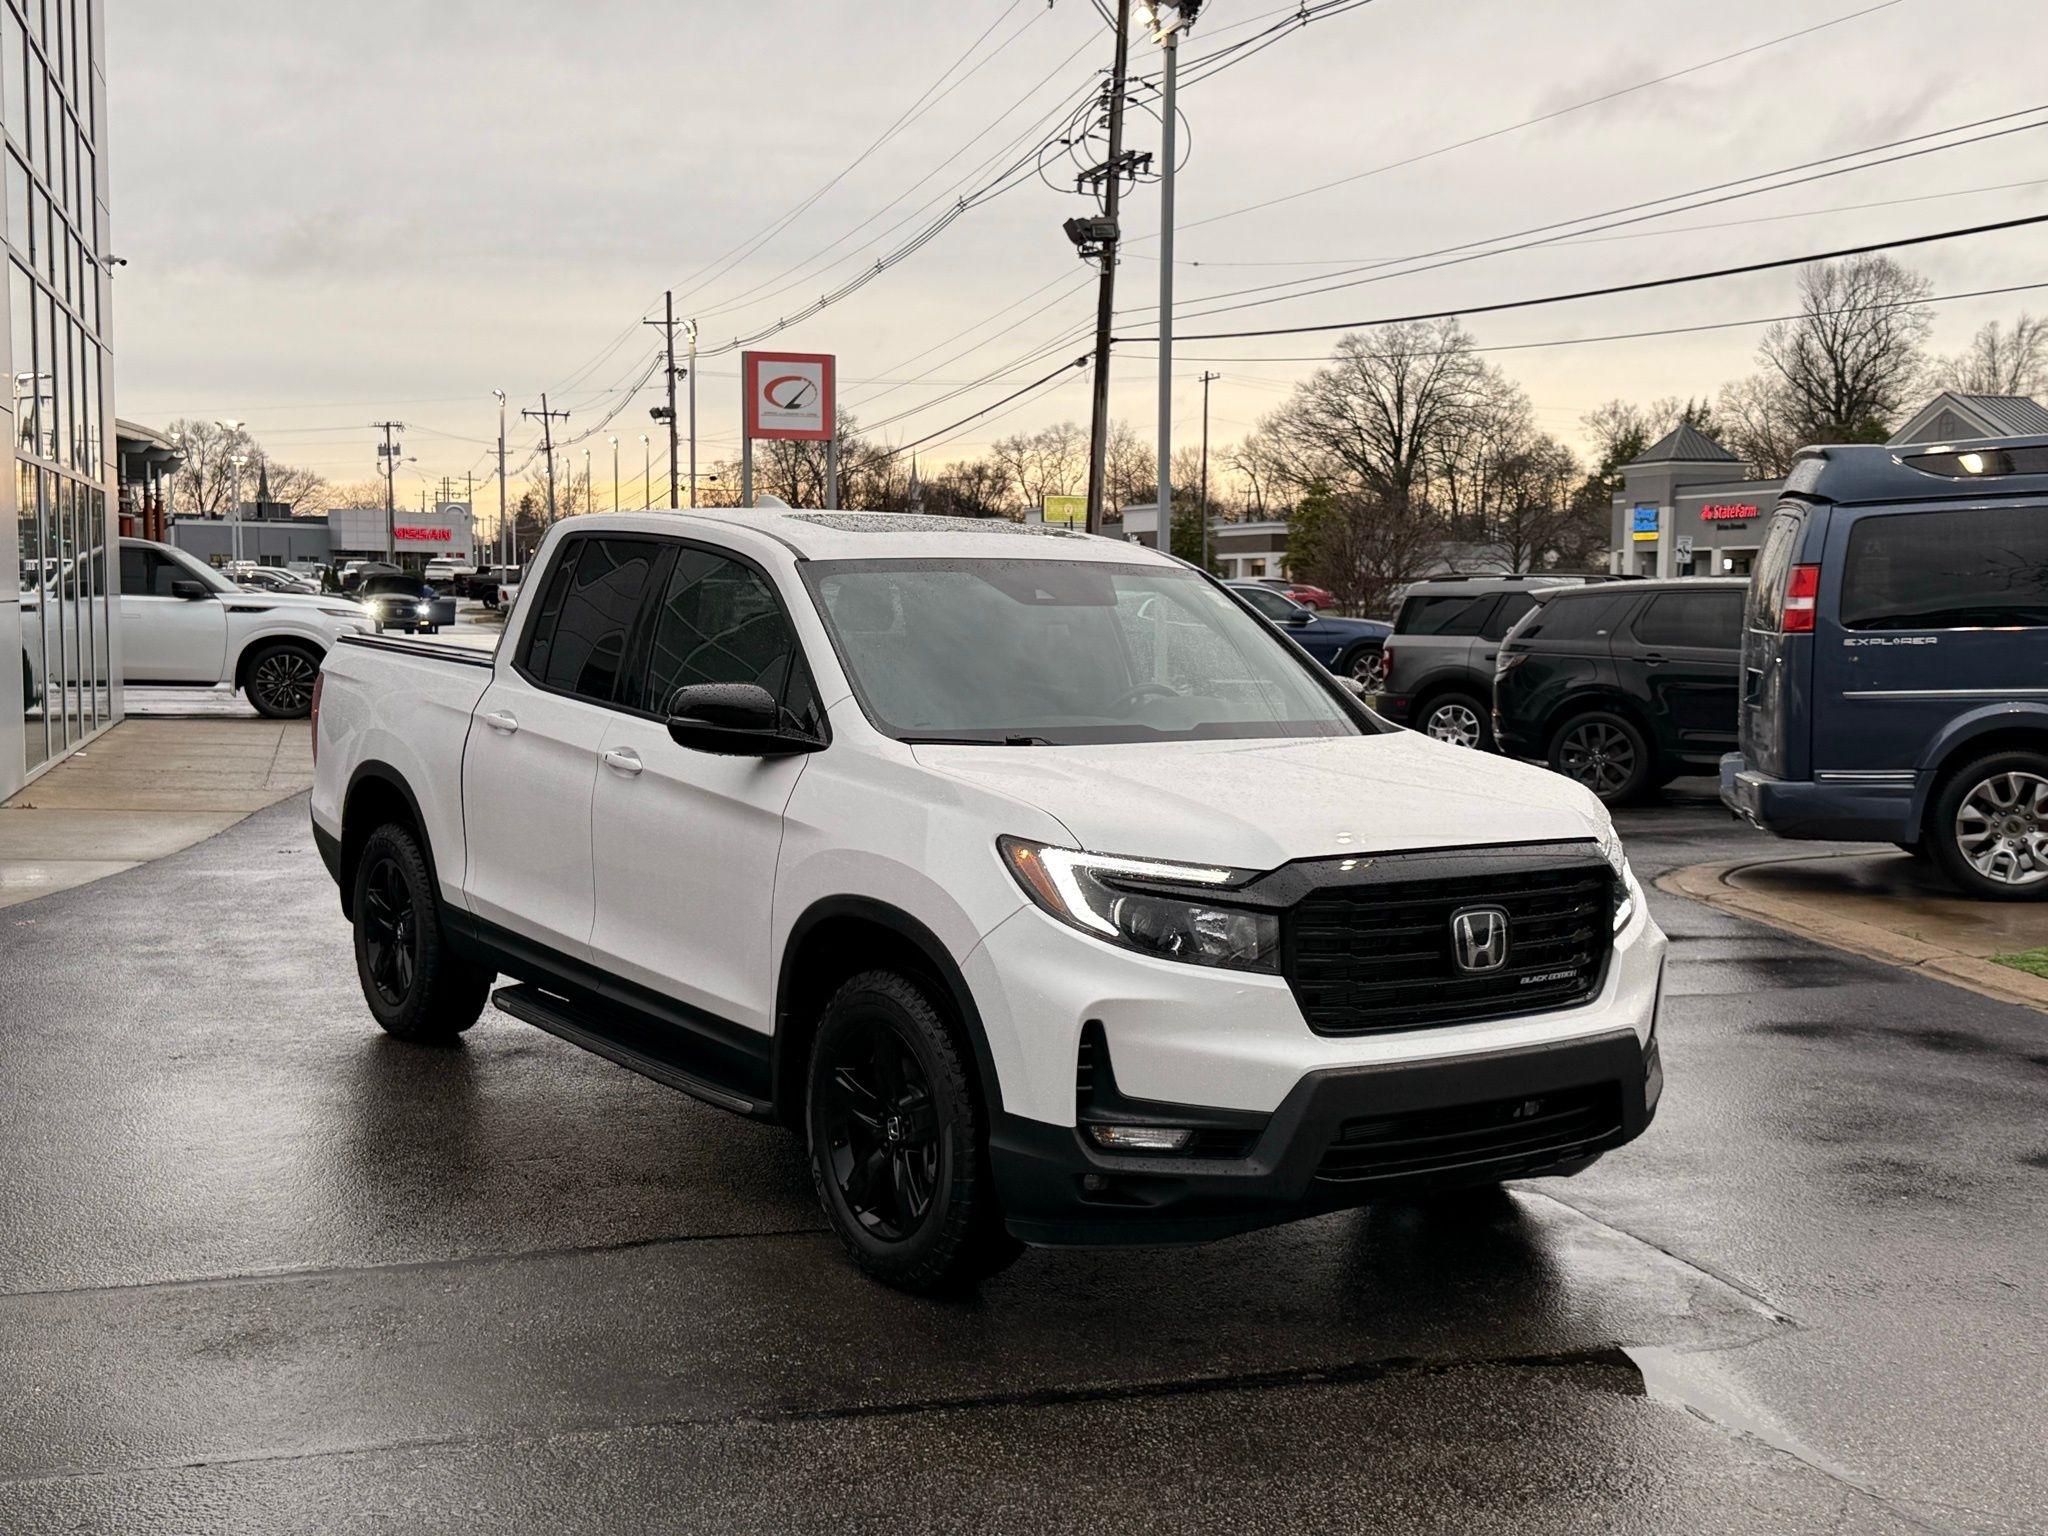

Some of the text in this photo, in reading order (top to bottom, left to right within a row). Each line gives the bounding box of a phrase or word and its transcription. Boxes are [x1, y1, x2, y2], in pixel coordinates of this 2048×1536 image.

[394, 528, 452, 541] NISSAN
[1843, 637, 1938, 646] EXPLORER
[1520, 969, 1577, 984] BLACK EDITION
